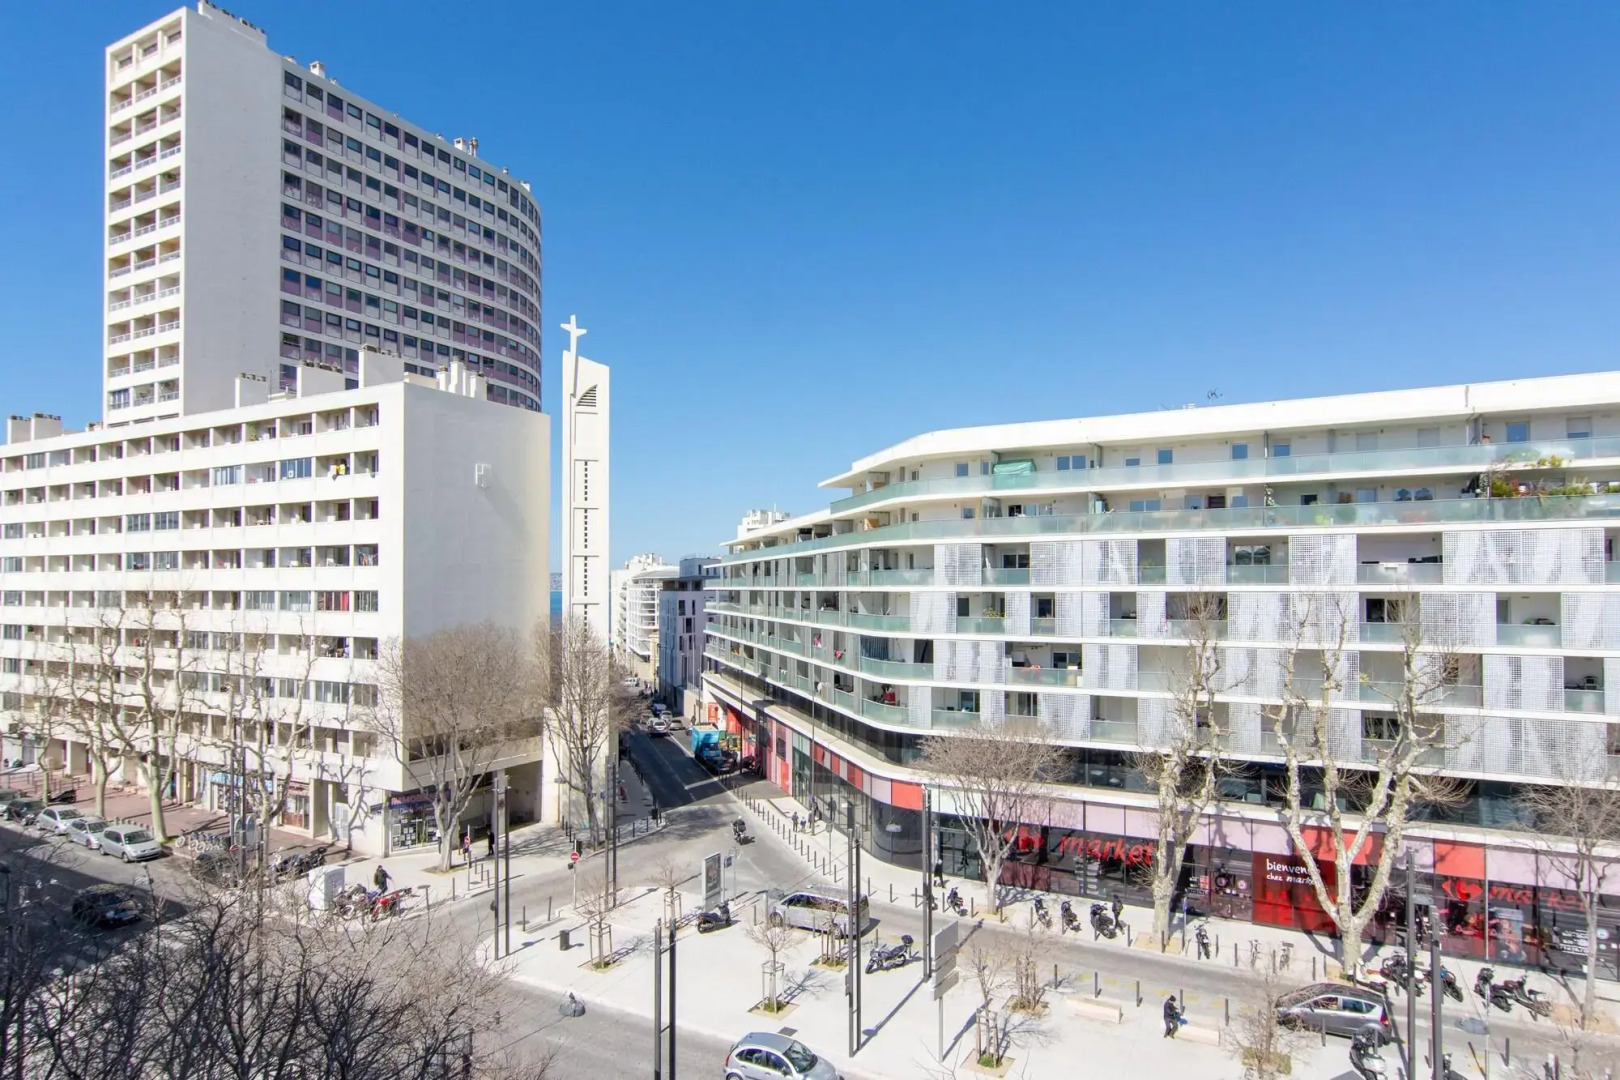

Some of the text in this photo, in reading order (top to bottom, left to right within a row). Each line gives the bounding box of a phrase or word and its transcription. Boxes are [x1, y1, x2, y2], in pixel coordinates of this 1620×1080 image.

[1059, 836, 1154, 866] market
[1266, 858, 1320, 876] bienven
[1286, 875, 1315, 886] marke
